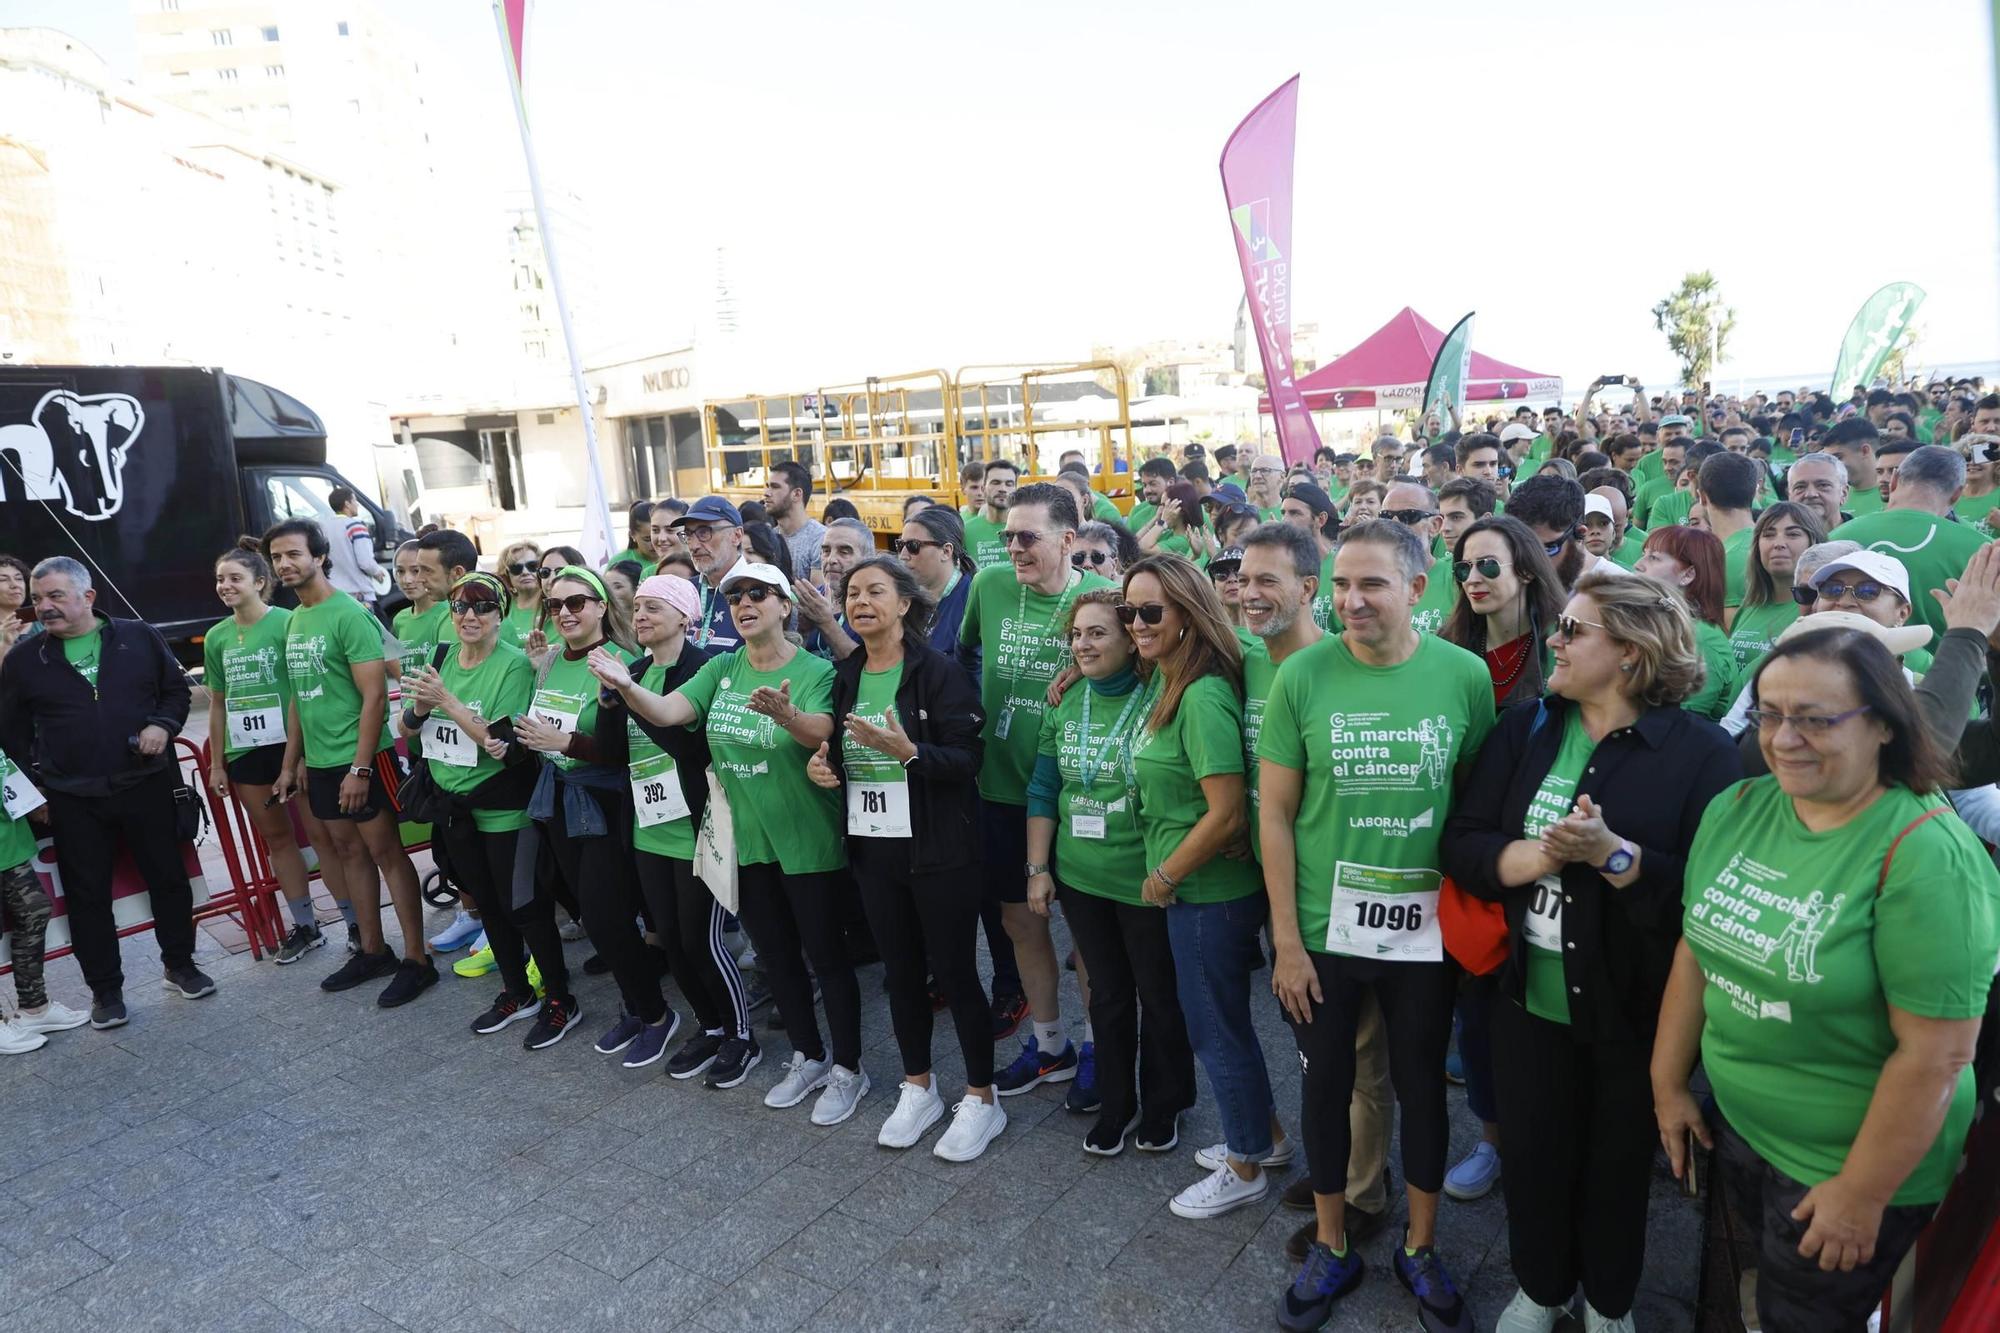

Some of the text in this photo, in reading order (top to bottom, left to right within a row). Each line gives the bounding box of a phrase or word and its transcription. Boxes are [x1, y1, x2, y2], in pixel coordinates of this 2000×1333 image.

[1272, 262, 1287, 326] kutxa
[880, 516, 892, 529] XL
[1000, 629, 1016, 642] En
[997, 654, 1008, 665] el
[711, 699, 725, 709] En
[243, 715, 266, 732] 911
[707, 711, 742, 724] contra
[436, 726, 459, 745] 471
[1064, 731, 1078, 743] En
[1331, 727, 1430, 743] En marcha
[1331, 744, 1390, 760] contra
[1060, 756, 1068, 767] el
[1333, 760, 1420, 777] el cáncer
[644, 782, 667, 804] 392
[861, 790, 887, 813] 781
[1350, 816, 1408, 829] LABORAL
[1382, 828, 1408, 838] kutxa
[1716, 867, 1740, 890] En
[1740, 882, 1811, 918] marcha
[1703, 886, 1762, 923] contra
[1355, 901, 1422, 931] 1096
[1691, 902, 1711, 921] el
[1710, 911, 1777, 952] cáncer
[1704, 968, 1760, 1009] LABORAL
[1731, 998, 1759, 1021] kutxa
